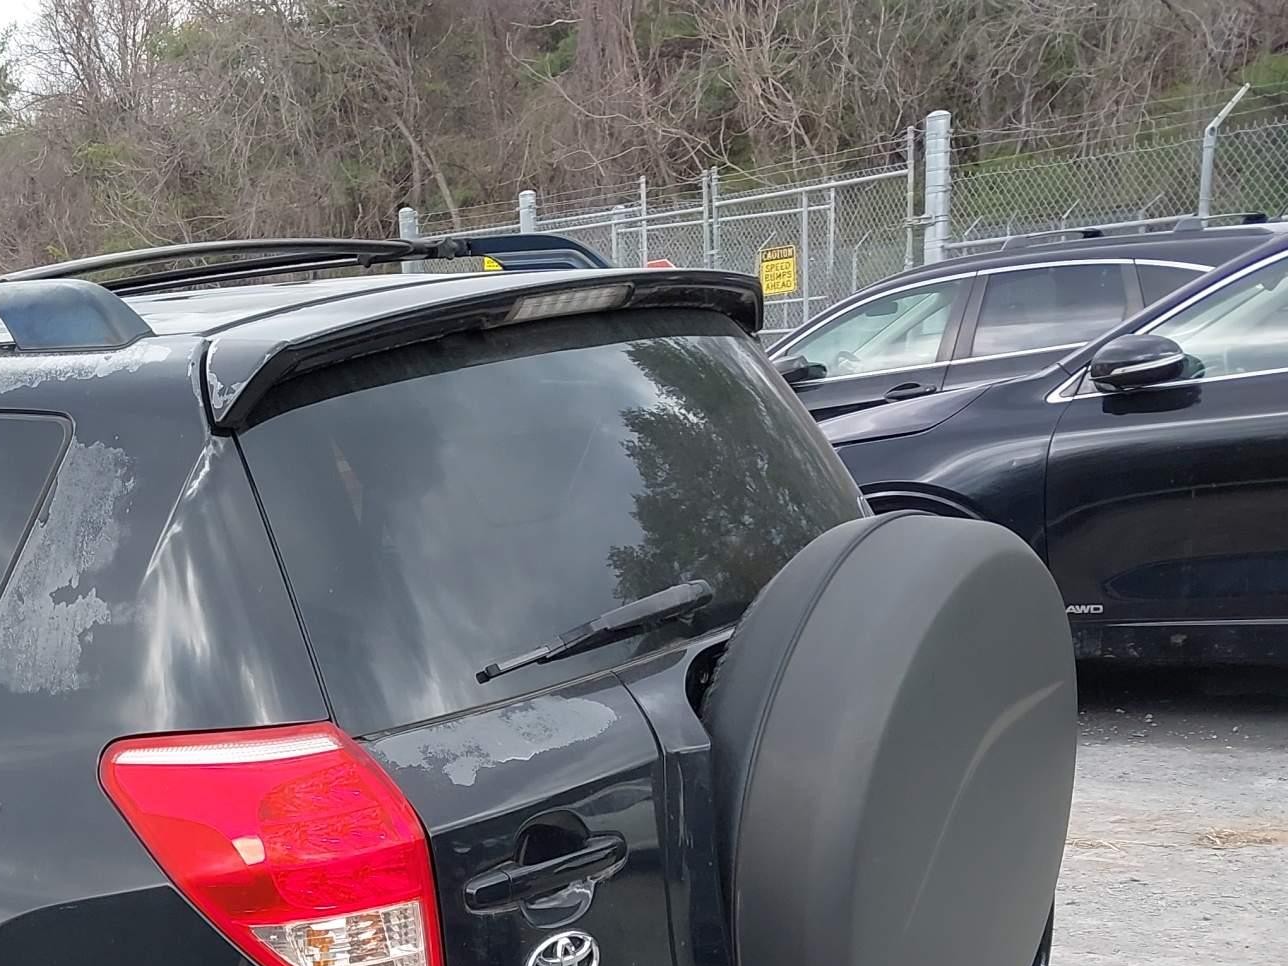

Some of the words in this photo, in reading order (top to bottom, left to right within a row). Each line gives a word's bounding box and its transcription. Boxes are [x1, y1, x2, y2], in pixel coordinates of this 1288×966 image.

[762, 247, 793, 260] CAUTION
[765, 261, 791, 272] SPEED
[765, 270, 792, 282] BUMPS
[766, 279, 792, 291] AHEAD
[1065, 604, 1104, 614] AWD
